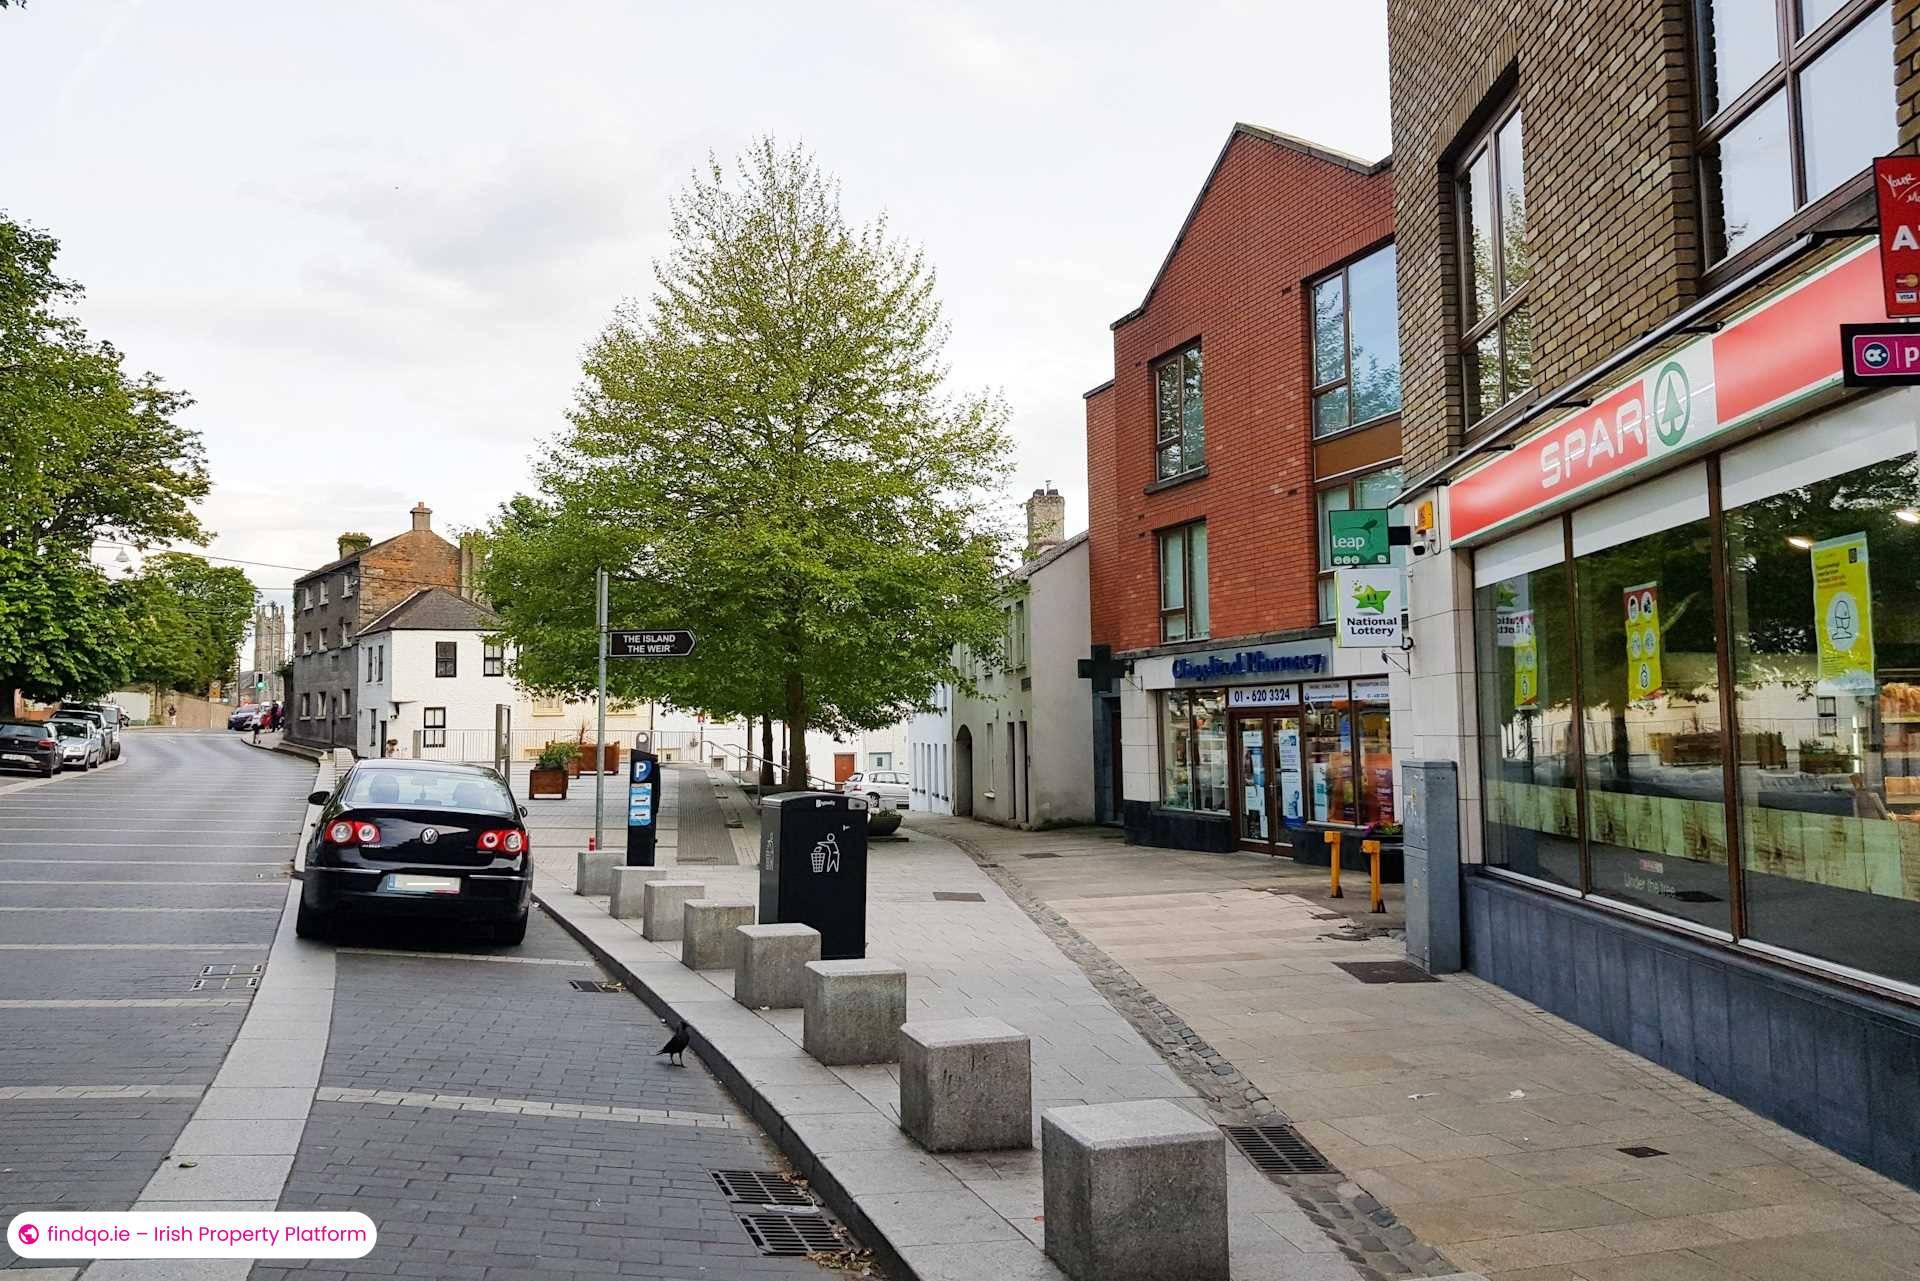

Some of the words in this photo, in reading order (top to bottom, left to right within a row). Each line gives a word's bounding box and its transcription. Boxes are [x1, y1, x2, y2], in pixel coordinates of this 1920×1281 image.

[1891, 224, 1920, 250] A
[1540, 398, 1644, 489] SPAR
[1332, 535, 1365, 550] leap
[1347, 617, 1397, 626] National
[623, 634, 641, 643] THE
[642, 634, 676, 643] ISLAND
[1351, 626, 1394, 637] Lottery
[627, 645, 645, 653] THE
[647, 644, 671, 653] WEIR
[1234, 690, 1244, 703] 01
[1251, 689, 1267, 702] 620
[1269, 687, 1290, 701] 3324
[635, 761, 647, 778] P
